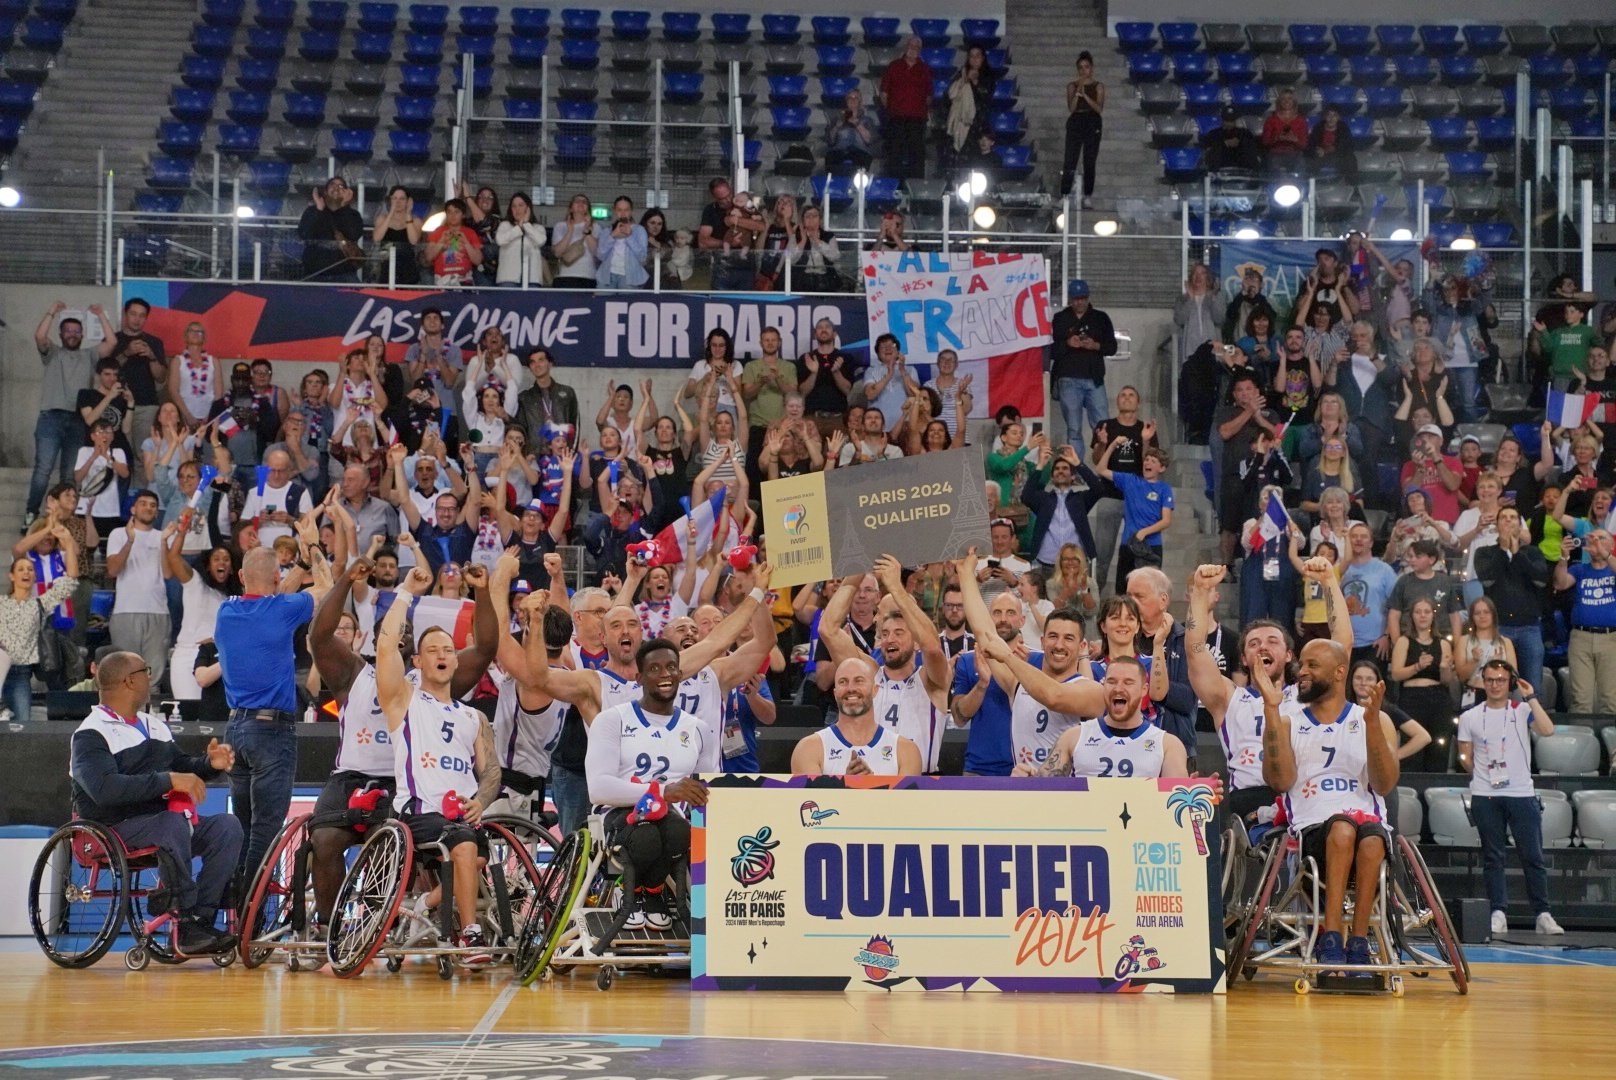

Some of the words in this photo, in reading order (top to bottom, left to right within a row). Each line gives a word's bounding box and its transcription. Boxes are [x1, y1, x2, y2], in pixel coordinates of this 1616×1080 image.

[902, 279, 926, 293] #25
[946, 274, 989, 296] LA
[887, 281, 1053, 354] FRANCE
[450, 303, 591, 350] CHANCE
[604, 302, 690, 358] FOR
[704, 303, 842, 360] PARIS
[858, 488, 907, 508] PARIS
[911, 481, 953, 499] 2024
[863, 503, 951, 529] QUALIFIED
[1581, 576, 1615, 588] FRANCE
[679, 693, 699, 714] 17
[885, 704, 899, 727] 4
[1036, 709, 1049, 733] 9
[441, 721, 455, 743] 5
[634, 753, 670, 777] 92
[1100, 757, 1134, 777] 29
[1321, 746, 1336, 768] 7
[804, 842, 1111, 920] QUALIFIED
[1135, 867, 1182, 892] AVRIL
[725, 889, 751, 900] LAST
[751, 890, 786, 901] CHANCE
[1136, 895, 1183, 913] ANTIBES
[725, 903, 747, 918] FOR
[750, 903, 785, 918] PARIS
[1136, 915, 1157, 928] AZUR
[1158, 915, 1184, 928] ARENA
[1014, 905, 1116, 977] 2024
